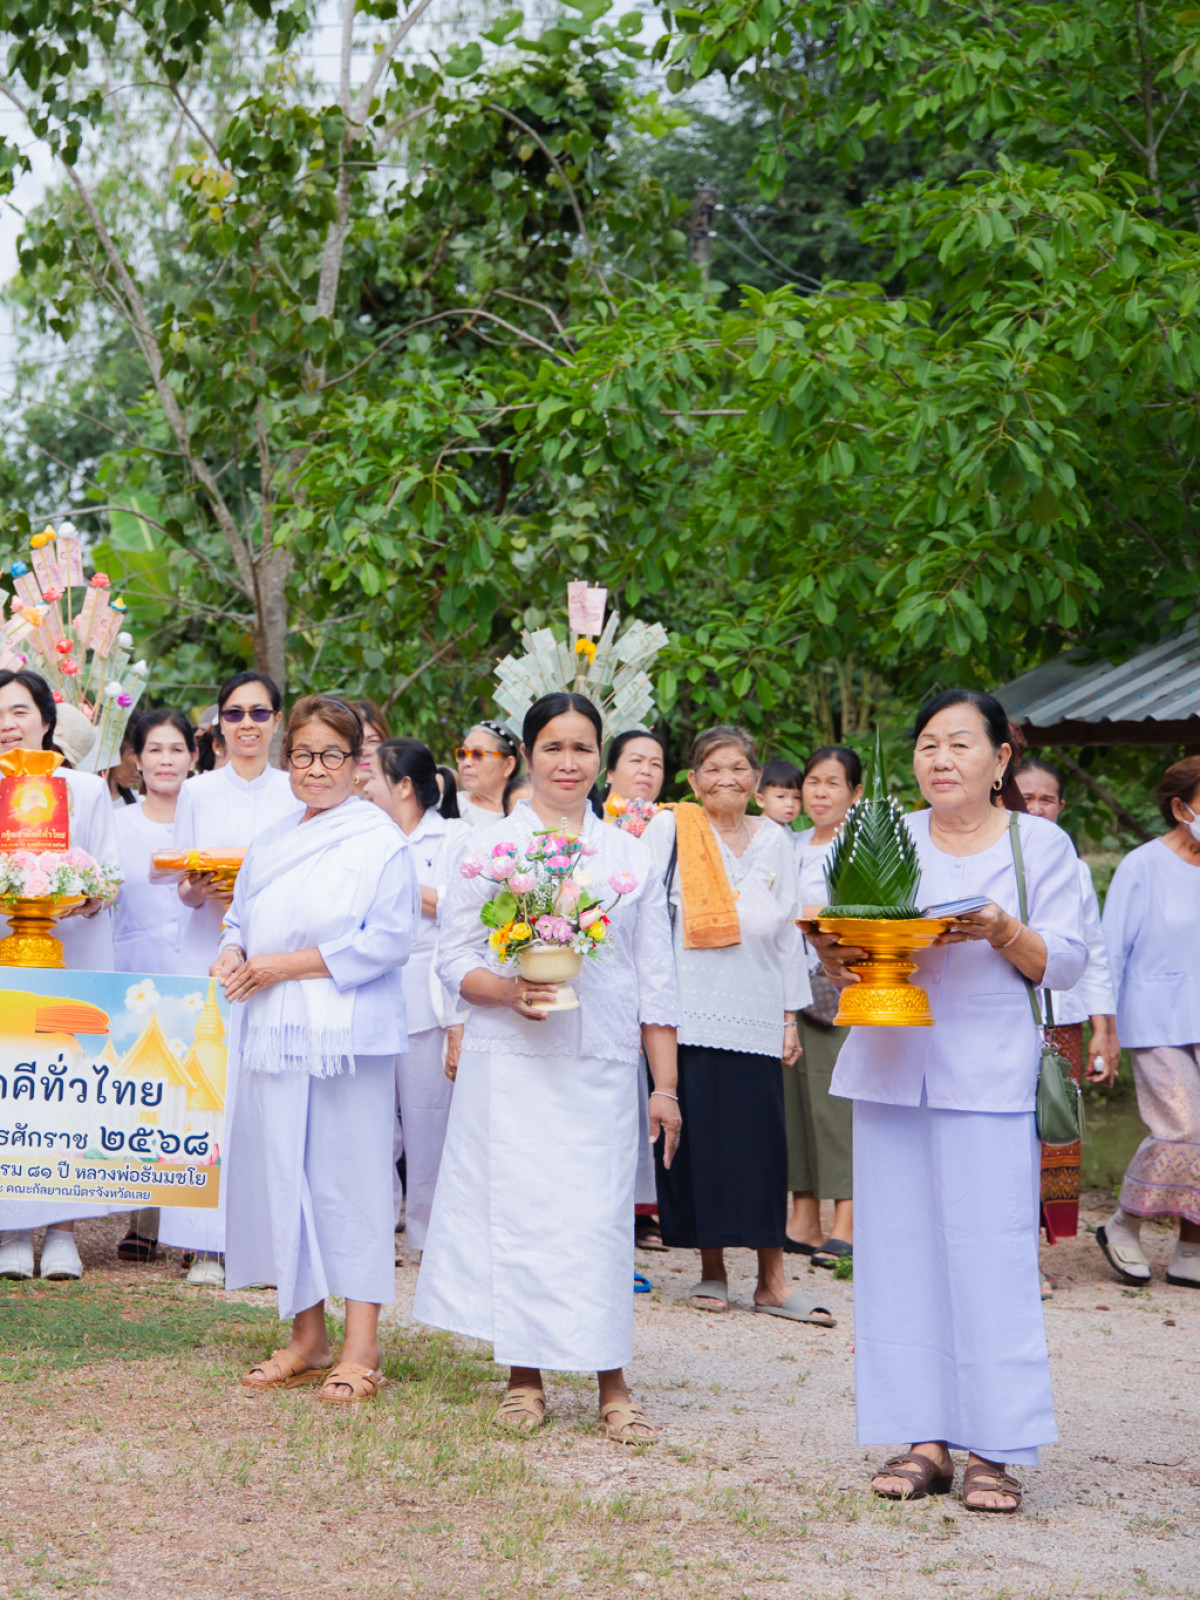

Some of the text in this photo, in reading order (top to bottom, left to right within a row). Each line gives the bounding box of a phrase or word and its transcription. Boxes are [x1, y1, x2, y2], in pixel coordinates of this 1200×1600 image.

[99, 1125, 210, 1156] ๒๕๖๘
[27, 1165, 53, 1179] ๘๑
[56, 1160, 70, 1179] ปี
[74, 1163, 207, 1186] หลวงพ่อธัมมชโย
[6, 1184, 151, 1200] คณะกัลยาณมิตรจังหวัดเลย
